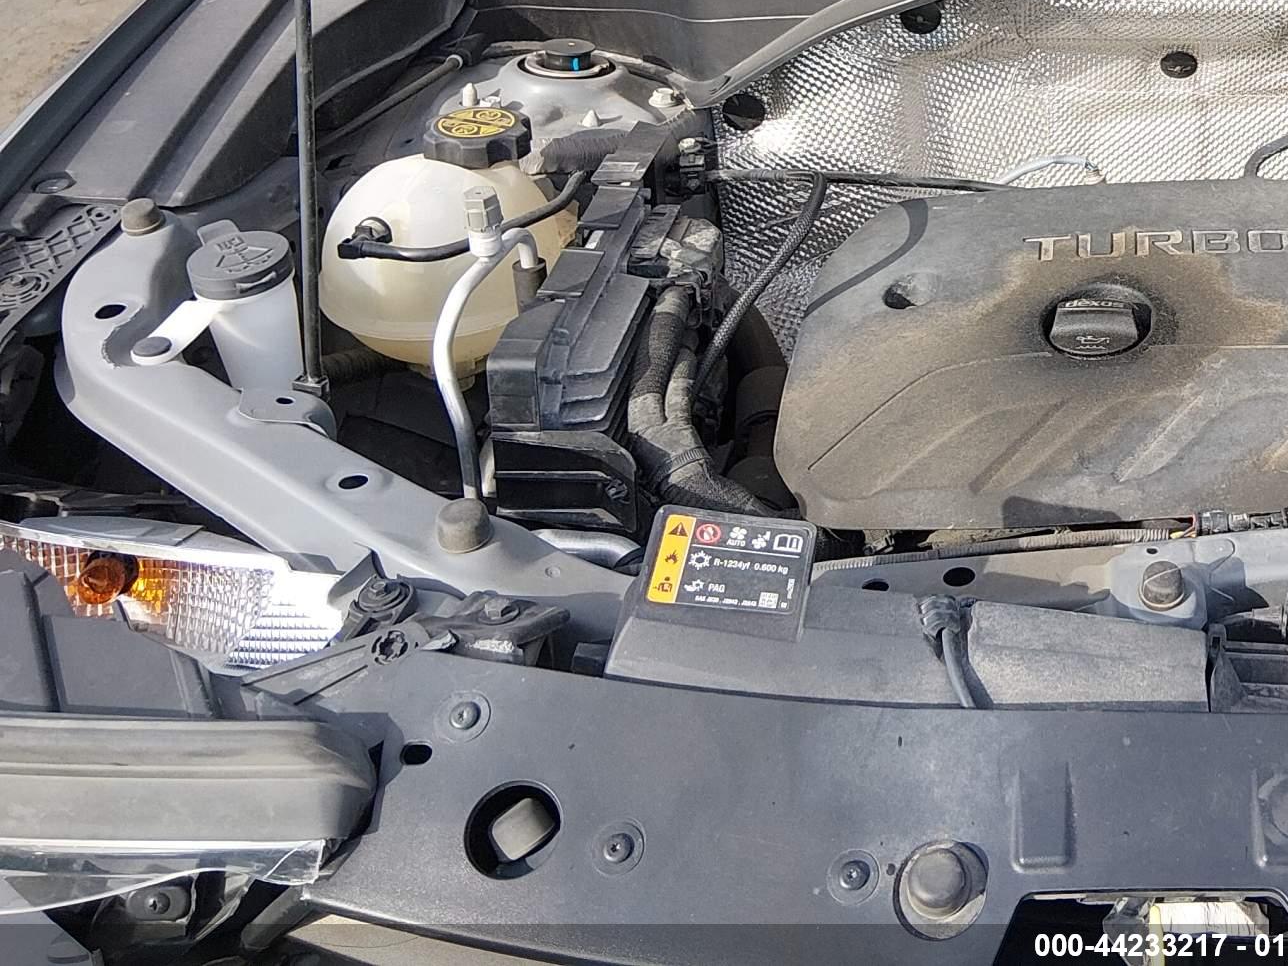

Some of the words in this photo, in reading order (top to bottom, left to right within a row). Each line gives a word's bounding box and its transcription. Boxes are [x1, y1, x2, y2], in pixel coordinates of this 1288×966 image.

[726, 538, 746, 547] AUTO
[714, 558, 751, 570] R-1234yf
[754, 563, 777, 573] 0.600
[777, 565, 789, 575] kg
[708, 583, 726, 593] PAG
